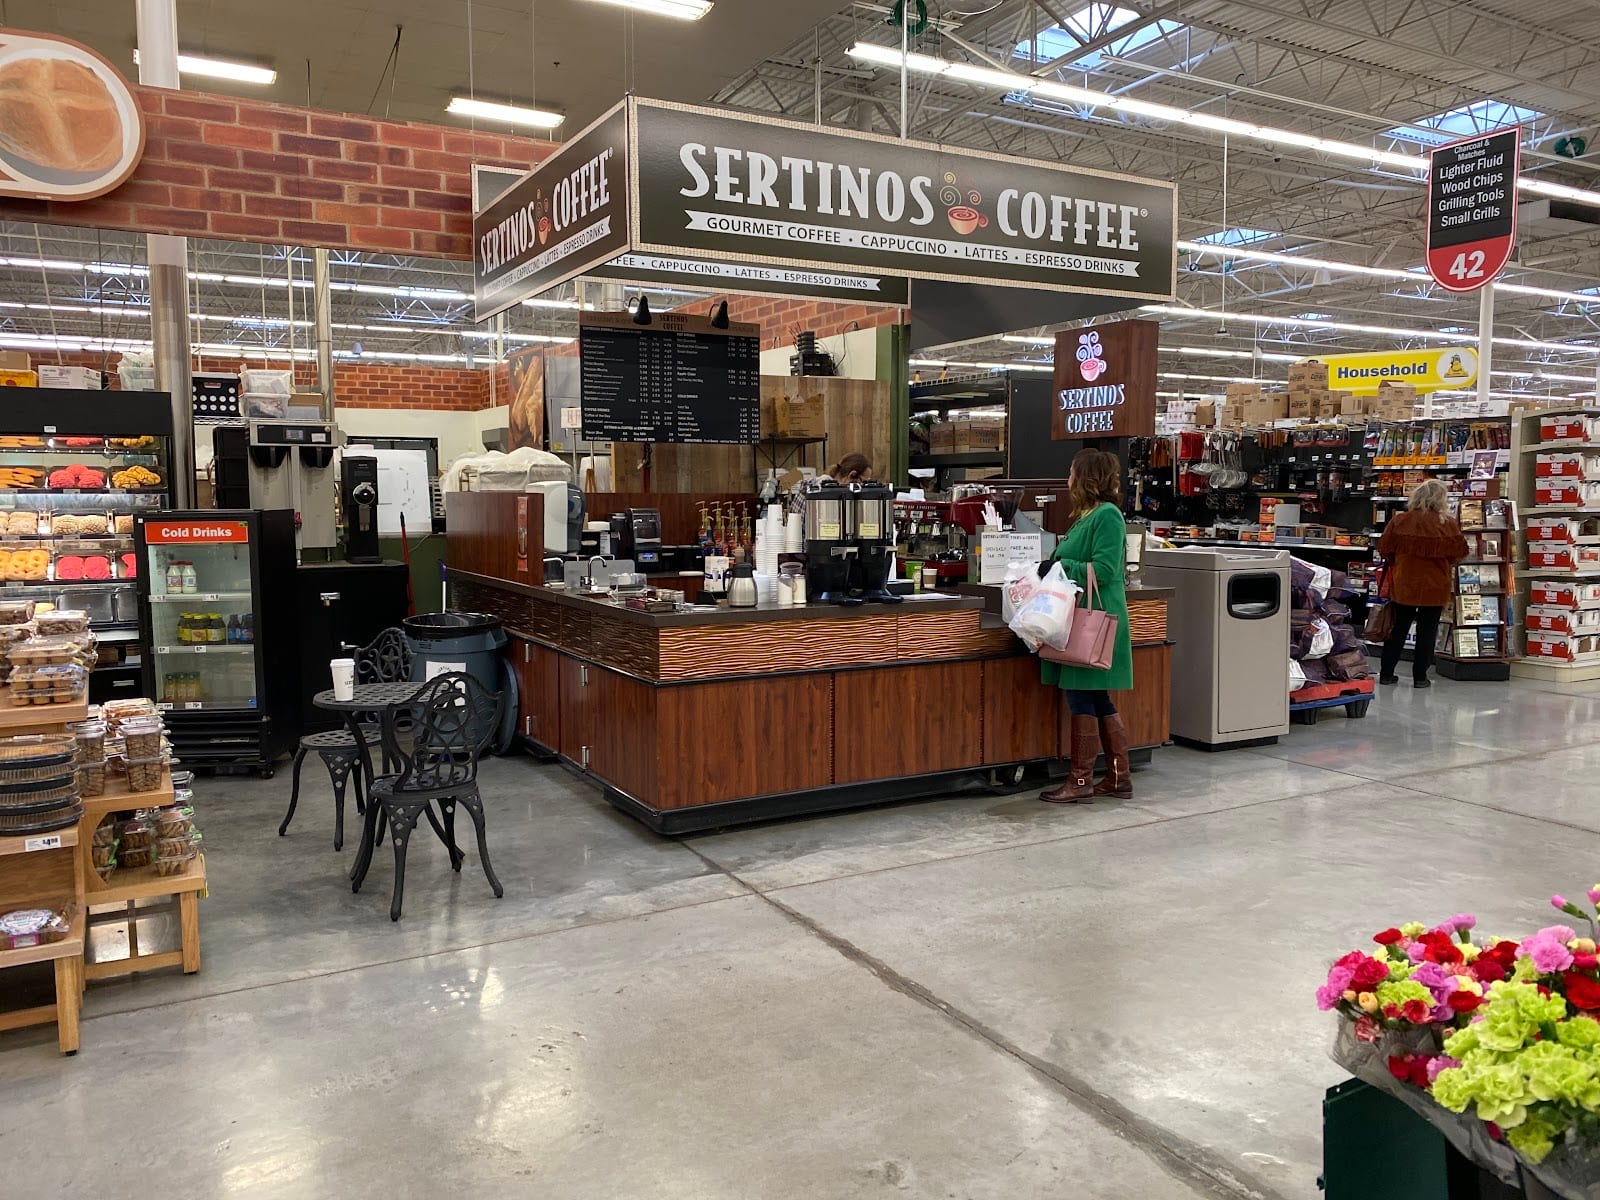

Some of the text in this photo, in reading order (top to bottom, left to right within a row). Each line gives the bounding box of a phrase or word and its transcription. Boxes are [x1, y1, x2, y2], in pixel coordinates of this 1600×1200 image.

[1454, 138, 1490, 154] Charcoal &
[1457, 149, 1486, 161] Matches
[1440, 153, 1503, 180] Lighter Fluid
[1442, 171, 1503, 194] Wood Chips
[679, 142, 1139, 251] SERTINOS COFFEE
[1438, 188, 1505, 212] Grilling Tools
[480, 149, 610, 277] SERTINOS COFFEE
[1441, 206, 1500, 227] Small Grills
[516, 258, 540, 279] CAPPUCCINO
[544, 249, 559, 265] LATTES
[563, 234, 585, 255] ESPRESSO
[585, 223, 604, 243] DRINKS
[707, 217, 1125, 274] GOURMET COFFEE CAPPUCCINO LATTES ESPRESSO DRINKS
[651, 259, 721, 275] CAPPUCCINO
[735, 267, 770, 281] LATTES
[784, 272, 832, 285] ESPRESSO
[833, 277, 868, 289] DRINKS
[1449, 250, 1486, 281] 42
[1338, 362, 1427, 379] Household
[1059, 384, 1125, 410] SERTINOS
[1066, 410, 1114, 433] COFFEE
[161, 526, 232, 538] Cold Drinks
